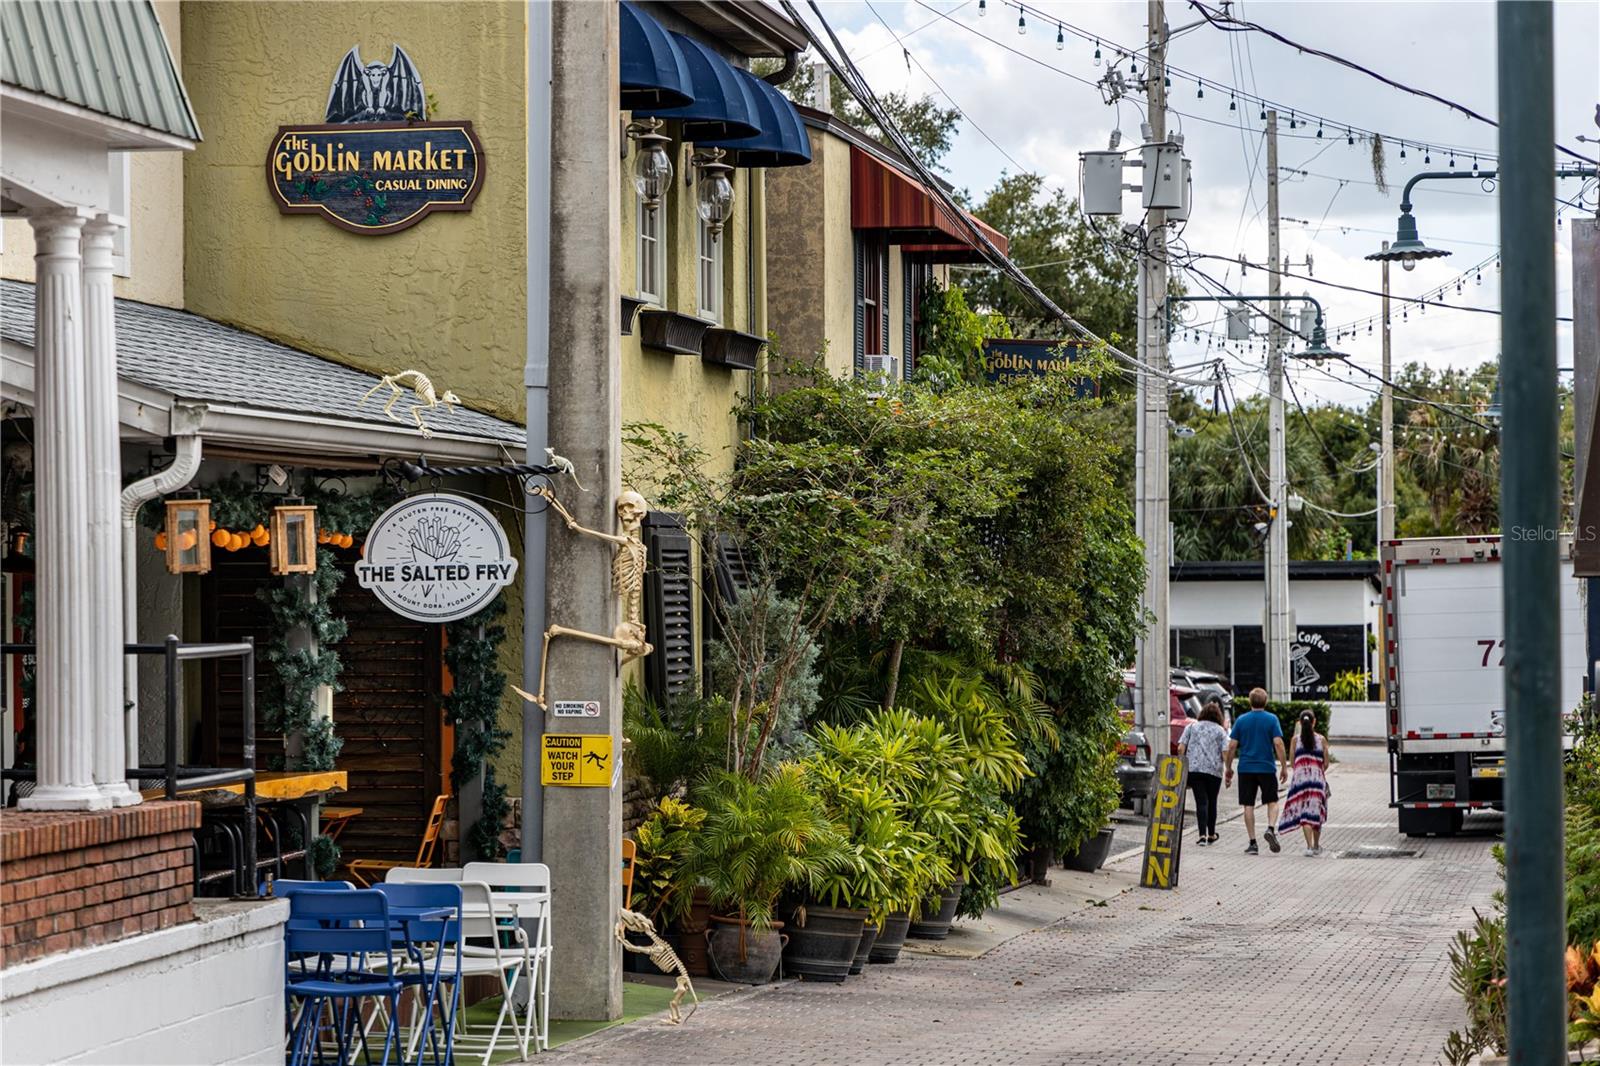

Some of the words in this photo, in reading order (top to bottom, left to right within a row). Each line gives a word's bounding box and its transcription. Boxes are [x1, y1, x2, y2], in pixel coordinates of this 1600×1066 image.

[375, 180, 422, 191] CASUAL
[426, 179, 468, 190] DINING
[398, 507, 427, 522] GLUTEN
[452, 508, 480, 526] EATERY
[1429, 548, 1440, 556] 72
[359, 566, 395, 582] THE
[401, 564, 470, 582] SALTED
[476, 563, 512, 581] FRY
[397, 593, 421, 607] MOUNT
[447, 592, 476, 608] FLORIDA
[1298, 631, 1331, 652] Coffee
[546, 738, 580, 746] CAUTION
[548, 752, 578, 760] WATCH
[551, 762, 575, 770] YOUR
[552, 772, 573, 780] STEP
[1146, 757, 1182, 887] OPEN
